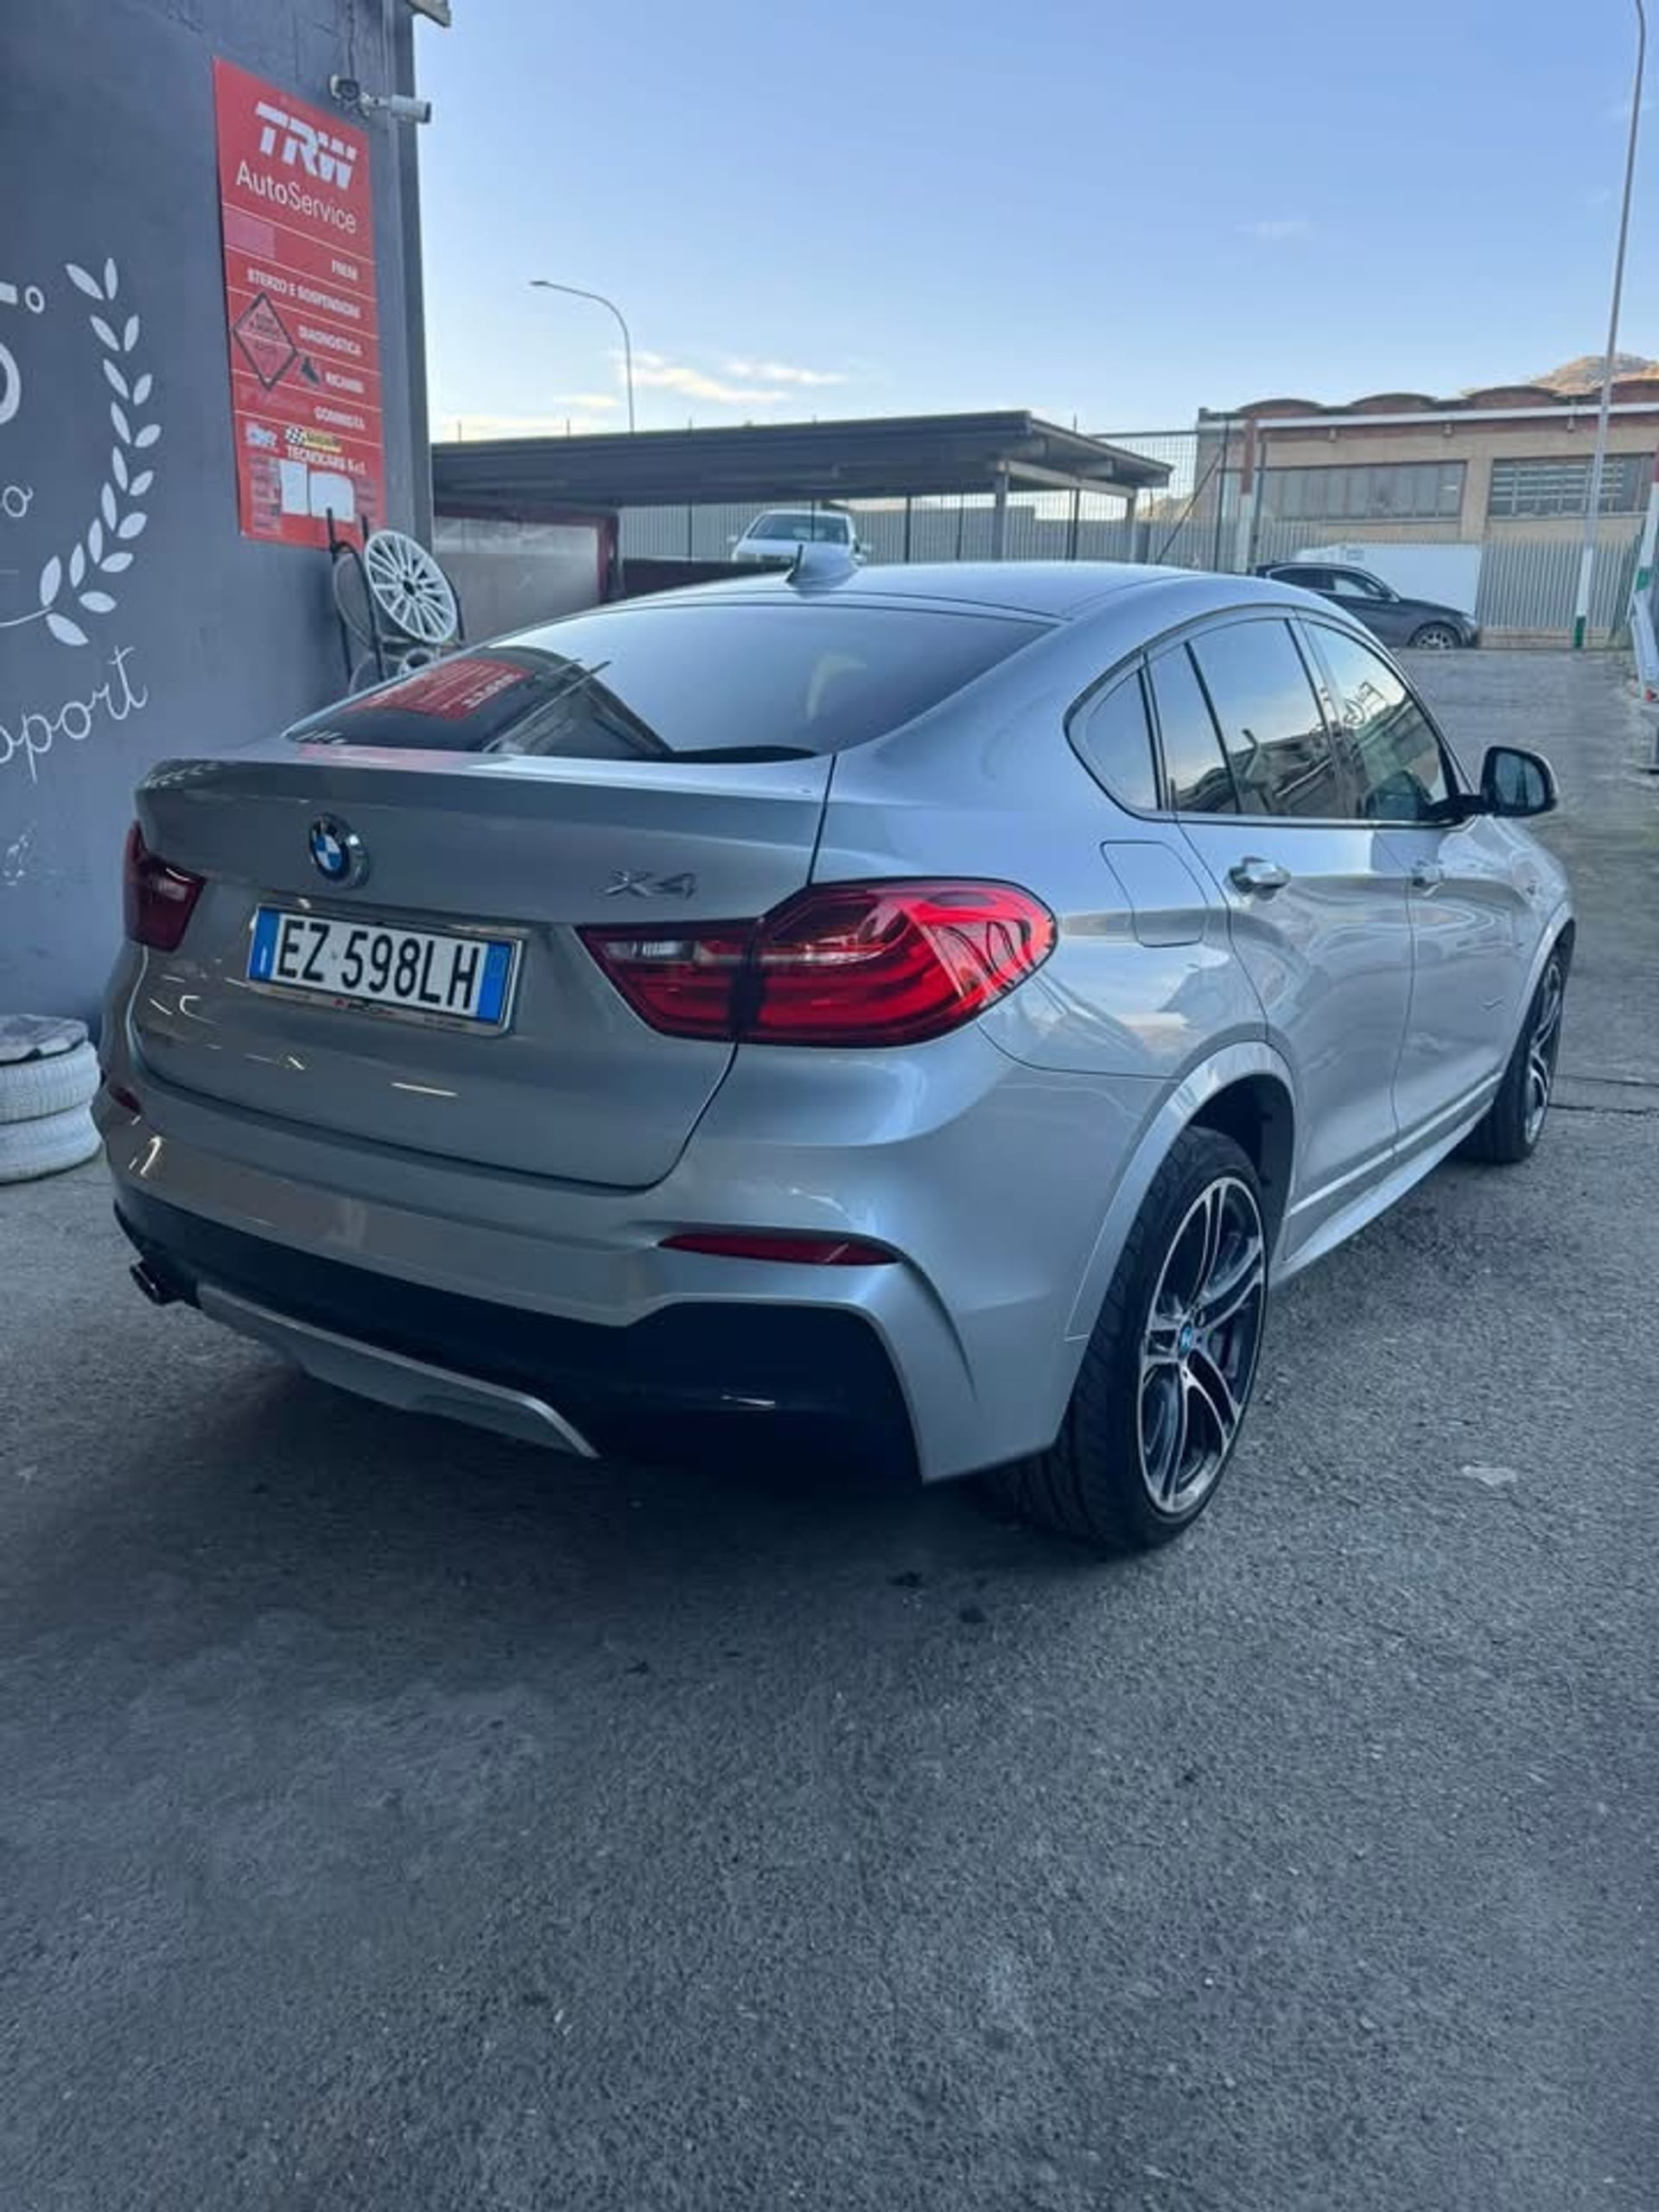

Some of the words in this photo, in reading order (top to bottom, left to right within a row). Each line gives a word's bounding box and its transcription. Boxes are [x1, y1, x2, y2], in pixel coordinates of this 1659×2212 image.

[255, 101, 357, 189] TRW
[236, 159, 357, 234] AutoService
[289, 283, 296, 296] E
[604, 868, 696, 899] X4
[277, 918, 331, 982] EZ
[341, 930, 480, 1010] 598LH
